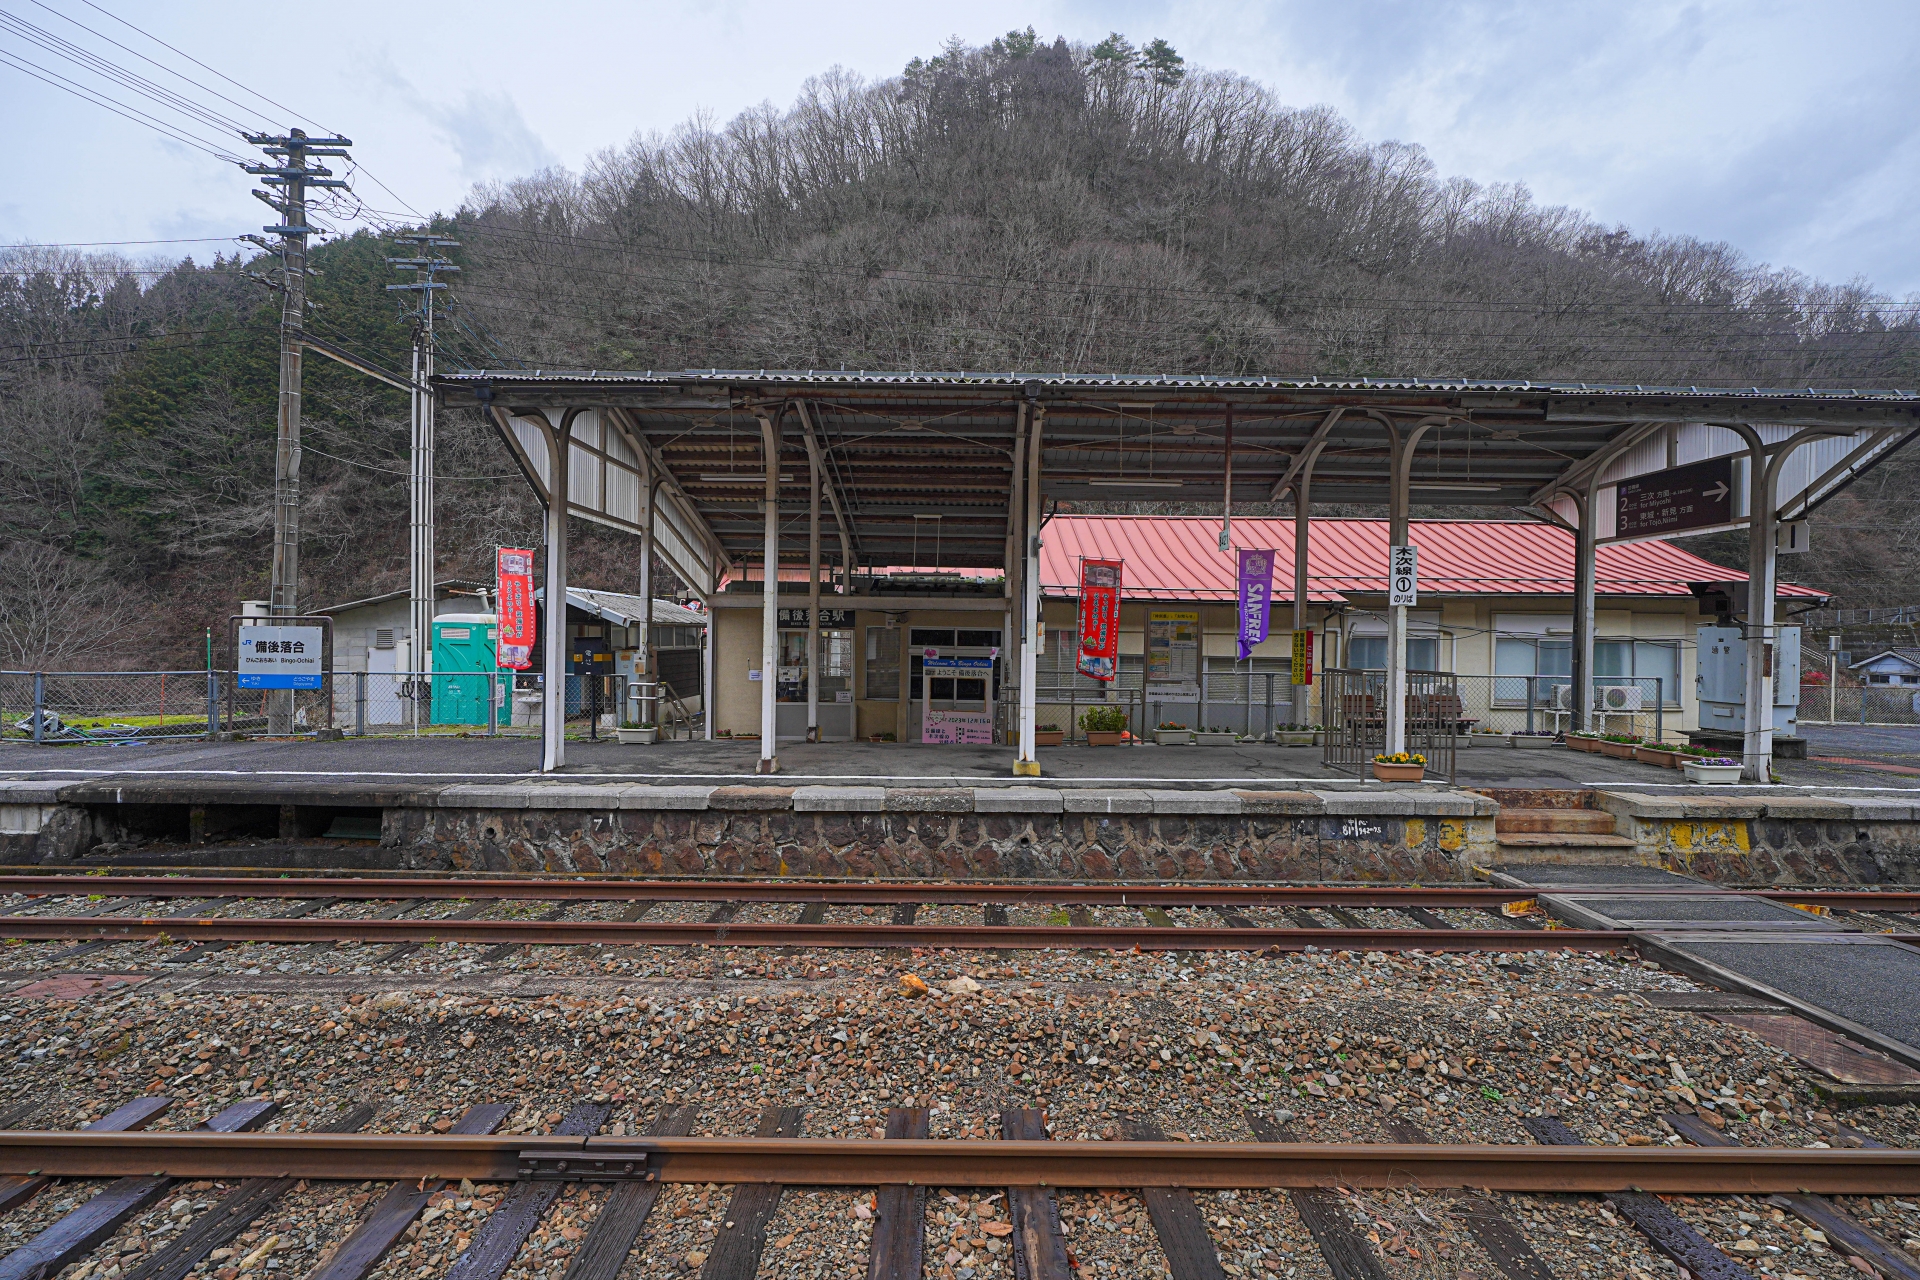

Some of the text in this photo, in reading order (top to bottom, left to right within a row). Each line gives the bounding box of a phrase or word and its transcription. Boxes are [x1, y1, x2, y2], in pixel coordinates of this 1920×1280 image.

[1640, 492, 1655, 501] 三次
[1657, 489, 1670, 498] 方面
[1620, 497, 1628, 512] 2
[1649, 497, 1672, 508] Miyoshi
[1679, 505, 1694, 514] 方面
[1620, 515, 1628, 530] 3
[1640, 520, 1649, 528] for
[1395, 547, 1413, 576] 木次線
[1394, 594, 1413, 603] のりば
[255, 641, 305, 653] 備後落合
